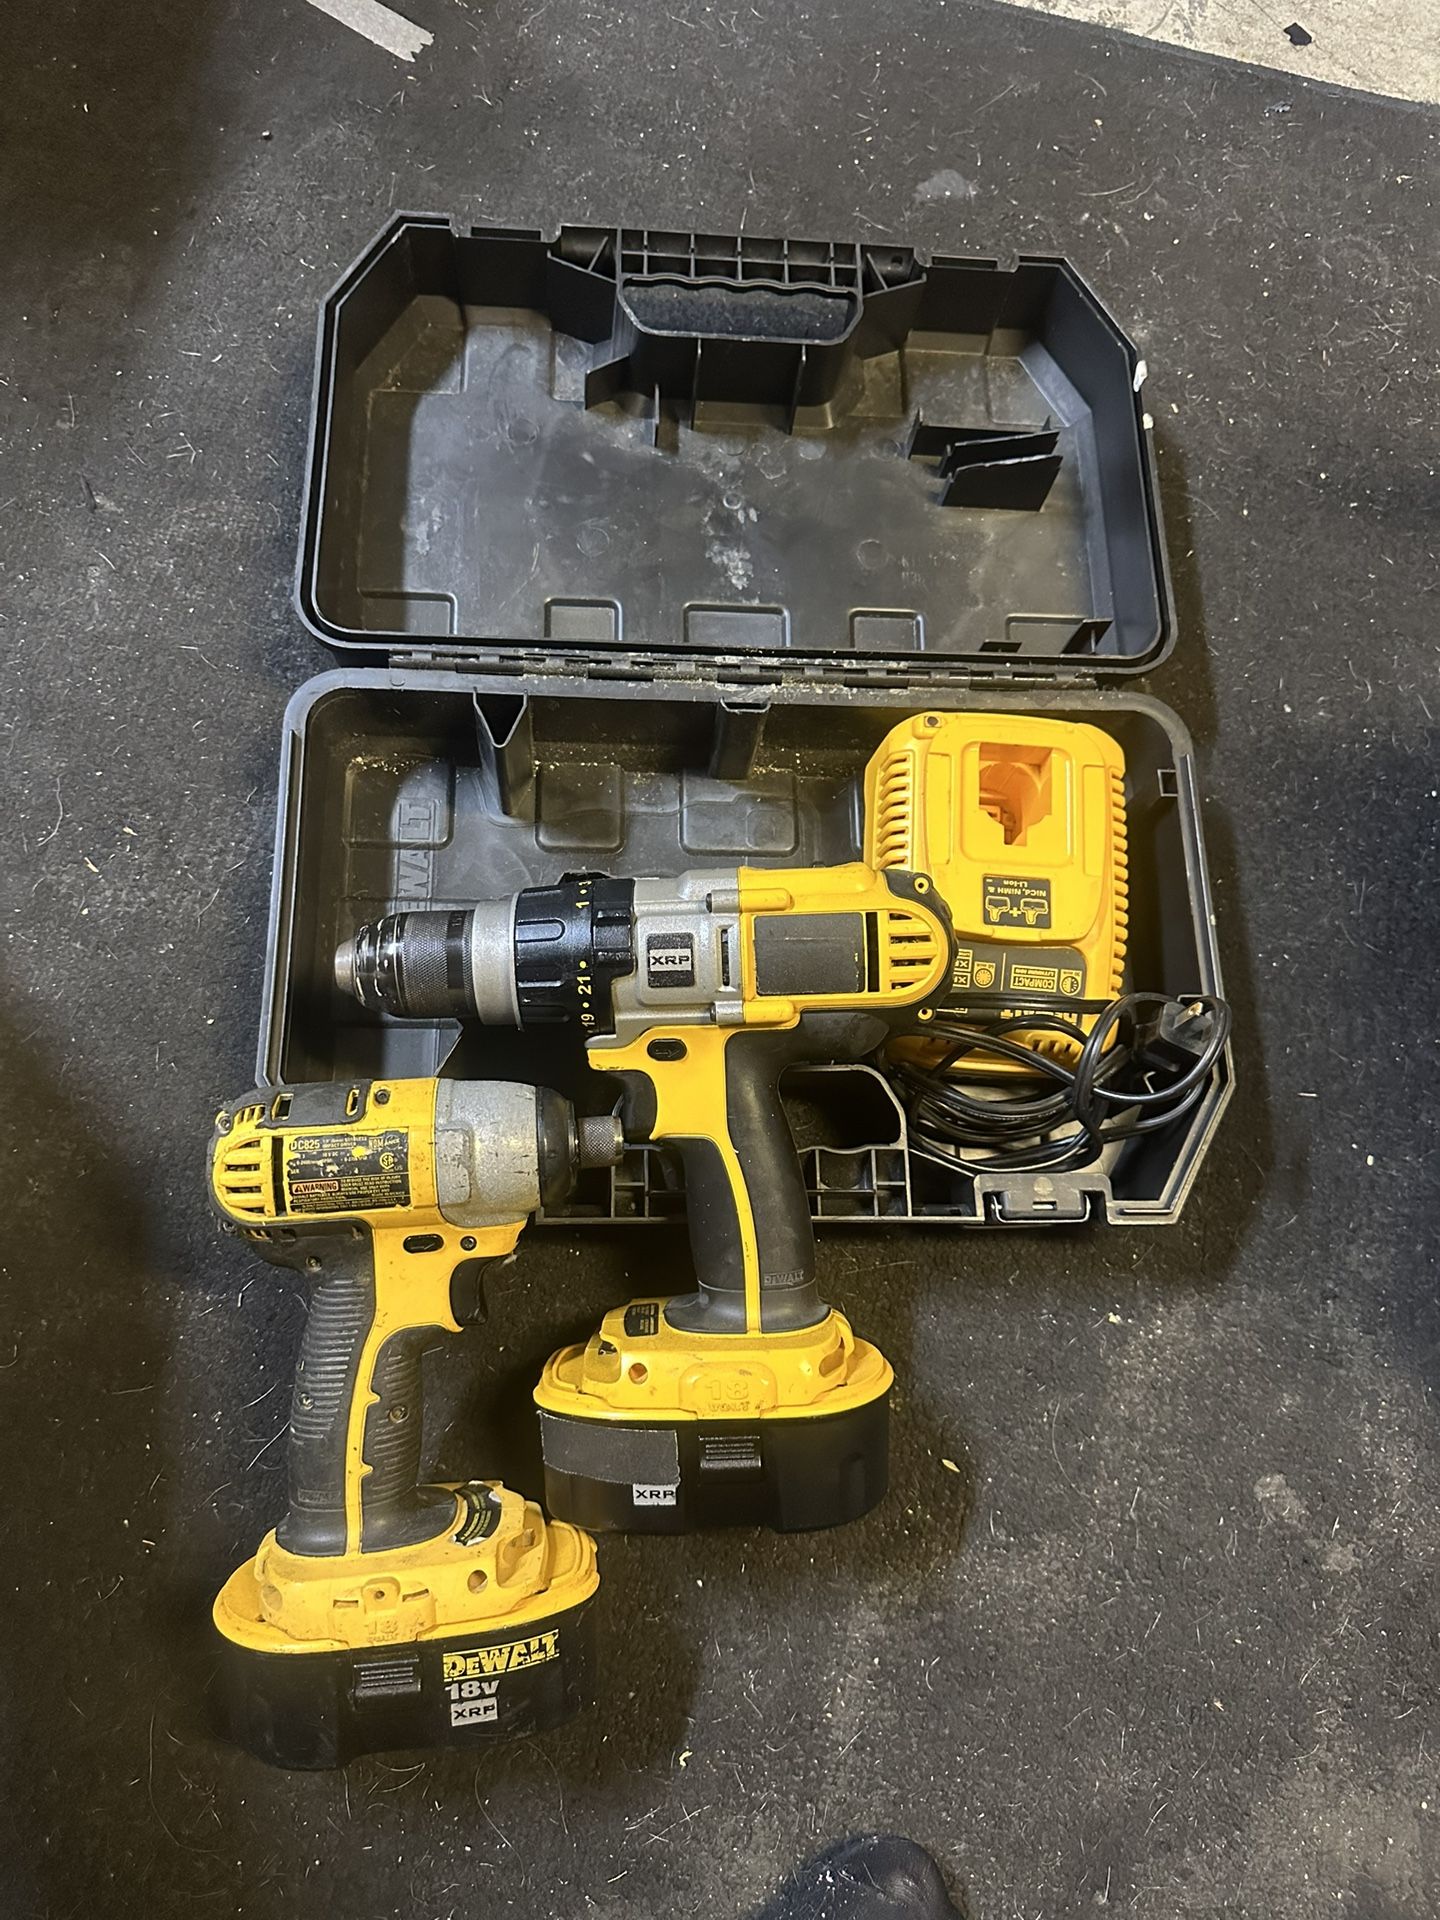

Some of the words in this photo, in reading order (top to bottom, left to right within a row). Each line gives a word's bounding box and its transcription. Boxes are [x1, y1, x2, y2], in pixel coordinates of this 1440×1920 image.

[987, 885, 996, 893] &
[997, 886, 1022, 895] NiMH
[576, 900, 590, 910] 1
[649, 954, 692, 968] XRP
[577, 975, 592, 996] 21
[1013, 976, 1054, 989] COMPACT
[580, 1013, 596, 1027] 19
[290, 1139, 321, 1151] DC825
[303, 1182, 337, 1193] WARNING
[705, 1379, 750, 1401] 18
[635, 1488, 676, 1500] XRP
[453, 1703, 496, 1720] XRP
